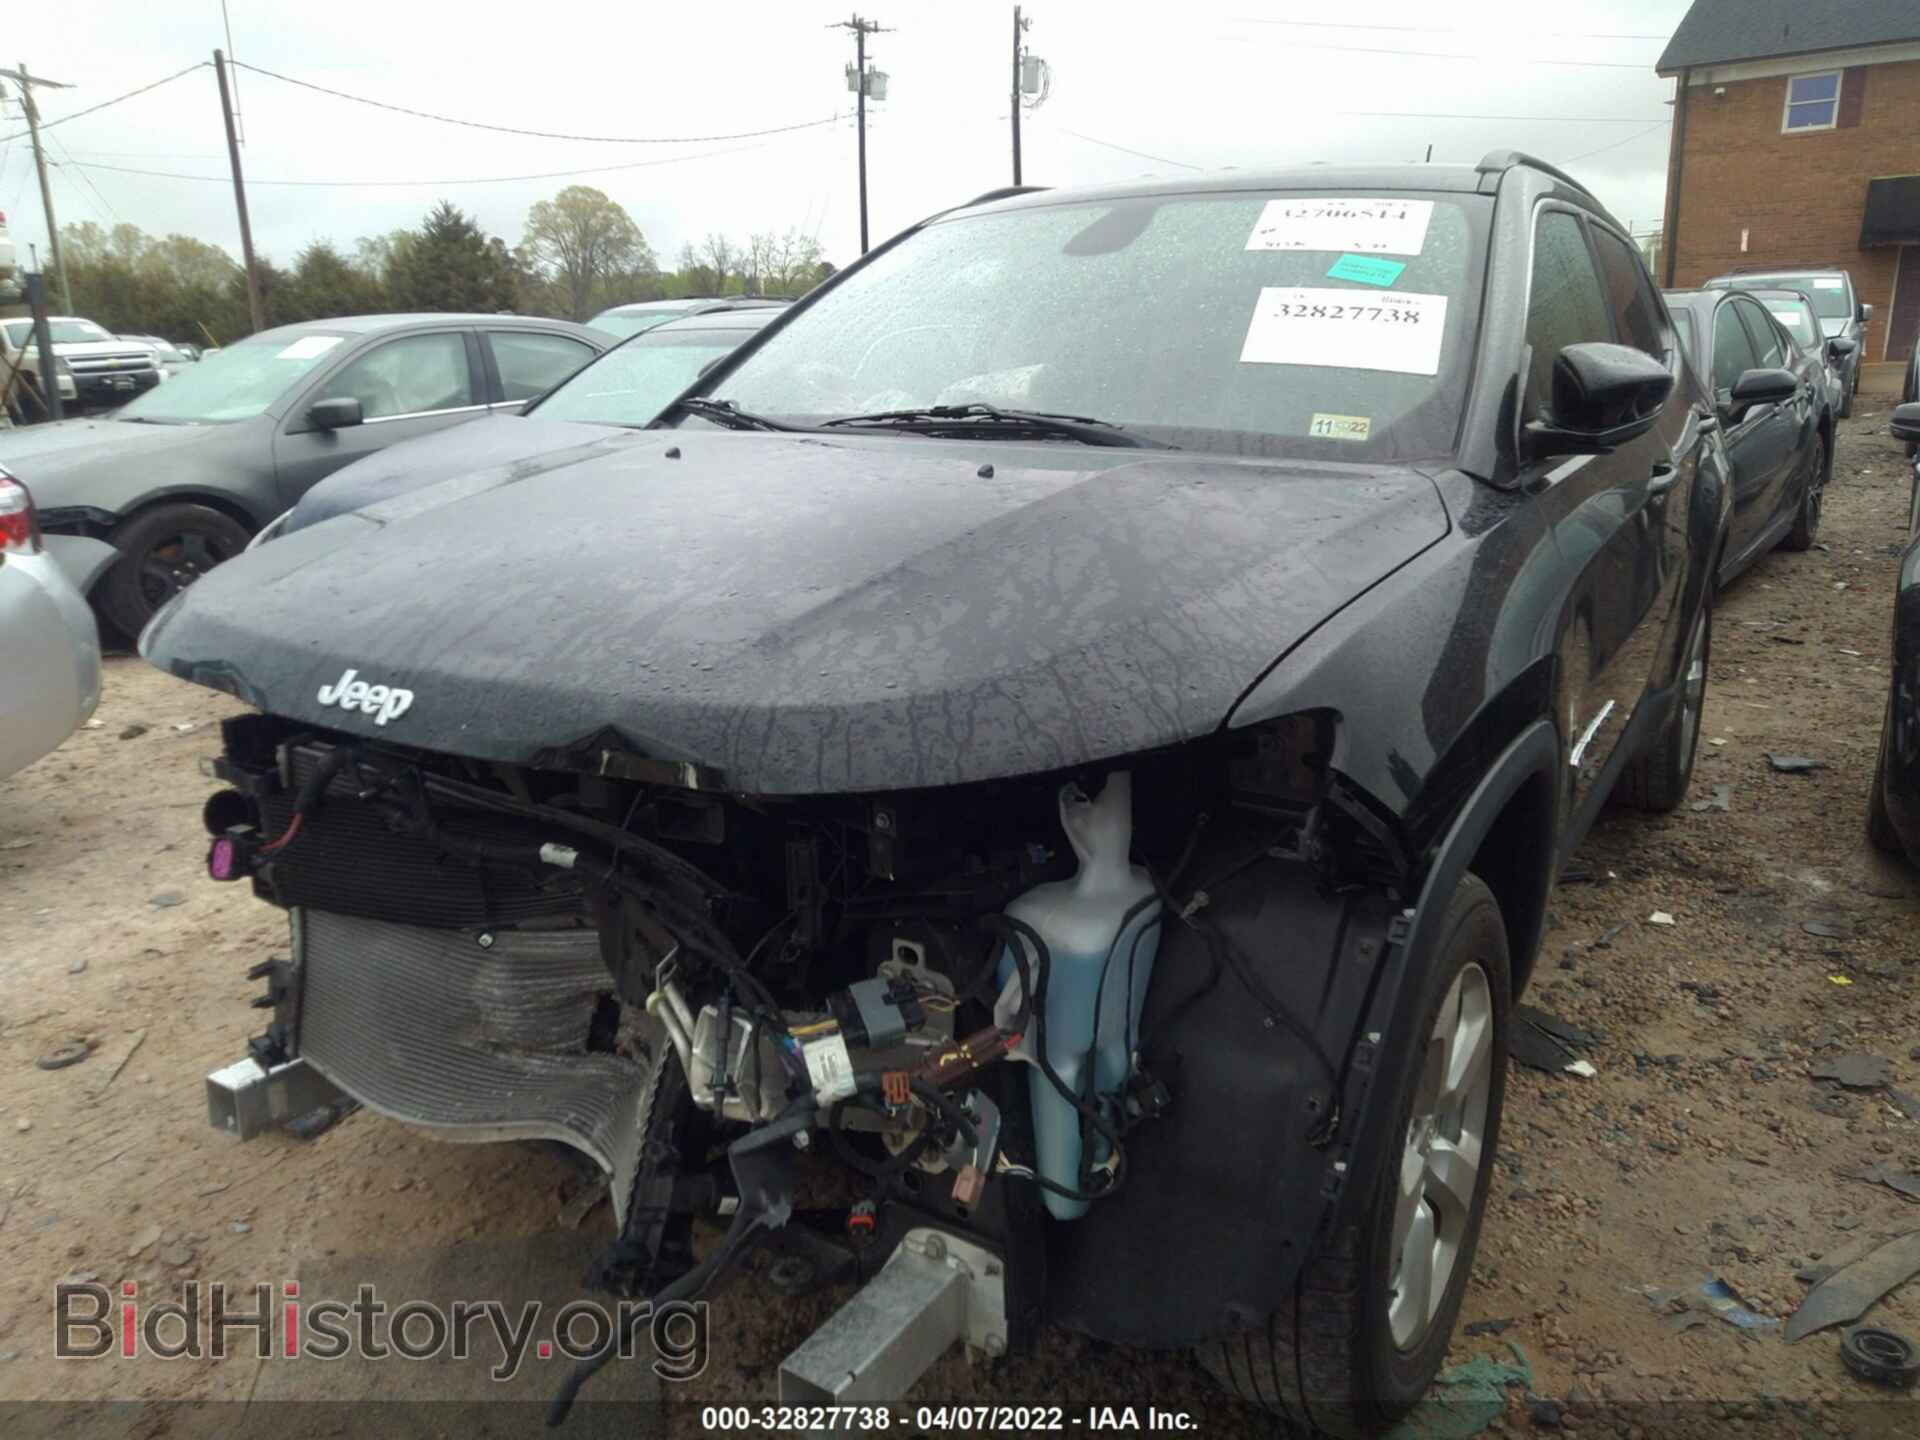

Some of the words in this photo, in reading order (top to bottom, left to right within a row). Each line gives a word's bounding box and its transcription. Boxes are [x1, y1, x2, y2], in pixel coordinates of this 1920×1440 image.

[1273, 303, 1421, 324] 32827738
[1317, 419, 1333, 434] 11
[1350, 422, 1367, 433] 22
[317, 669, 414, 726] Jeep
